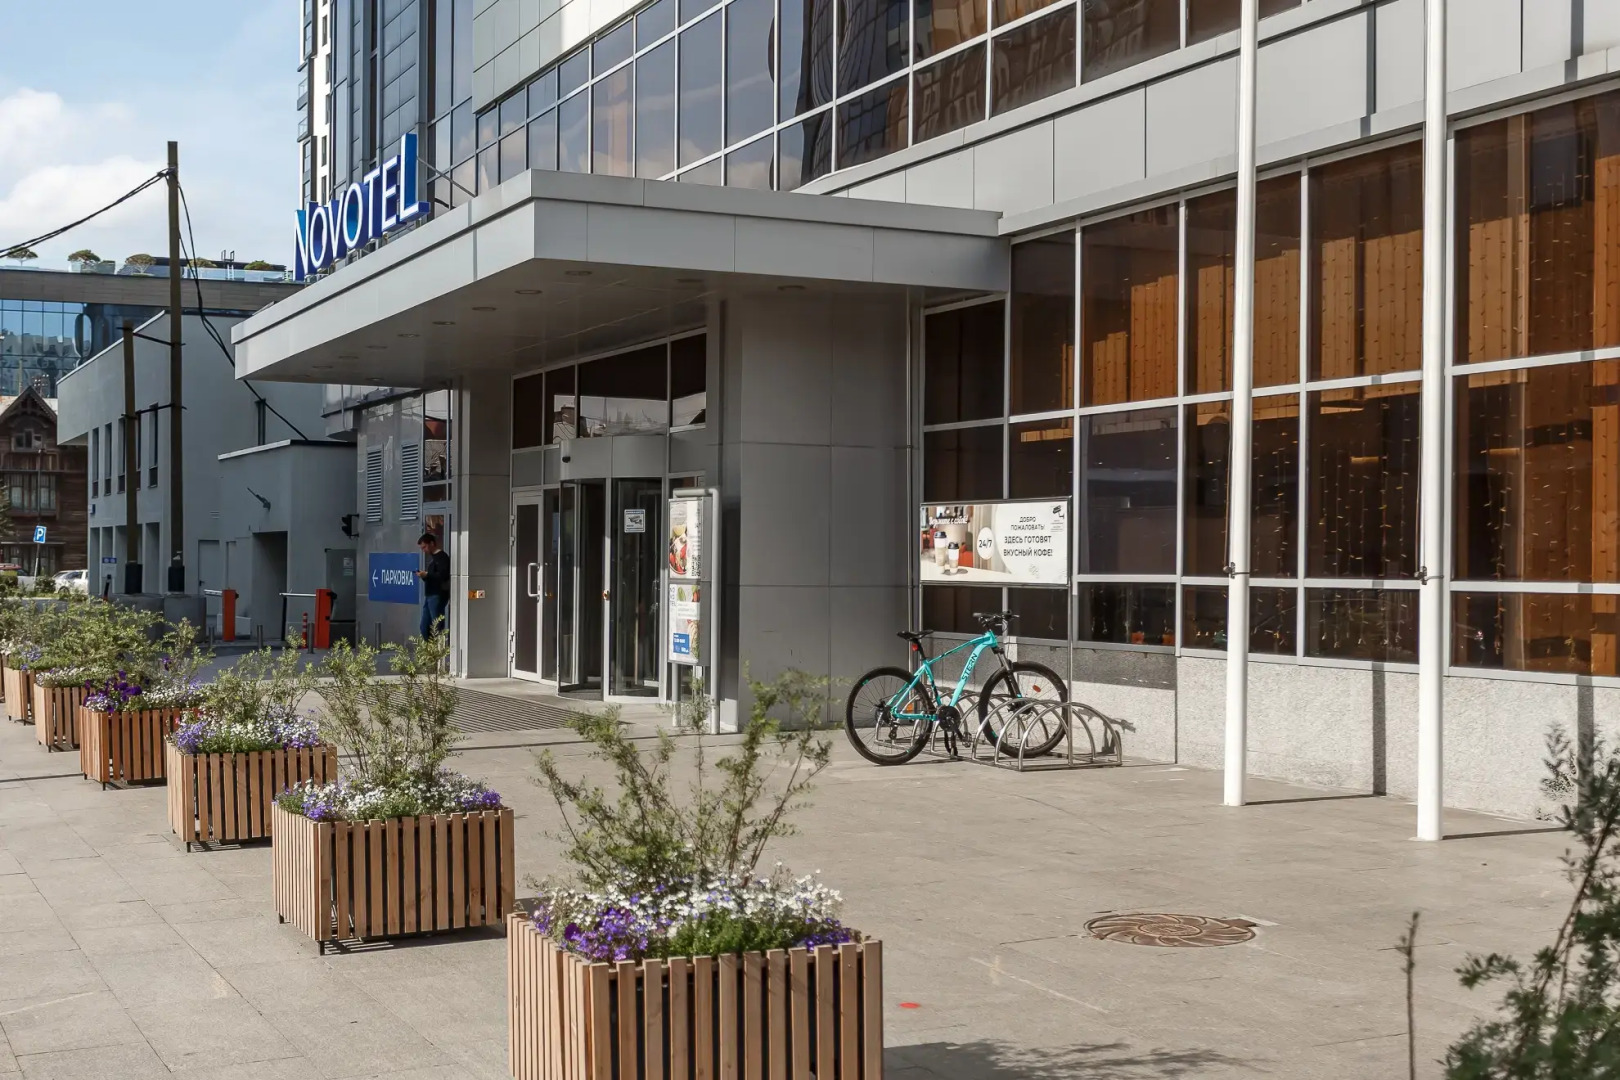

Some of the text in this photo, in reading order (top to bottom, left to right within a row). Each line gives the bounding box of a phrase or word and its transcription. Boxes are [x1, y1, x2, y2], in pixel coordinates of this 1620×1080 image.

[293, 133, 428, 281] NOVOTEL
[978, 540, 992, 548] 24/7
[1004, 535, 1052, 544] ЗДЕСЬ ГОТОВЯТ
[1004, 548, 1052, 556] ВКУСНЫЙ КОФЕ!
[382, 570, 414, 586] ПАРКОВКА
[961, 653, 978, 682] STERN
